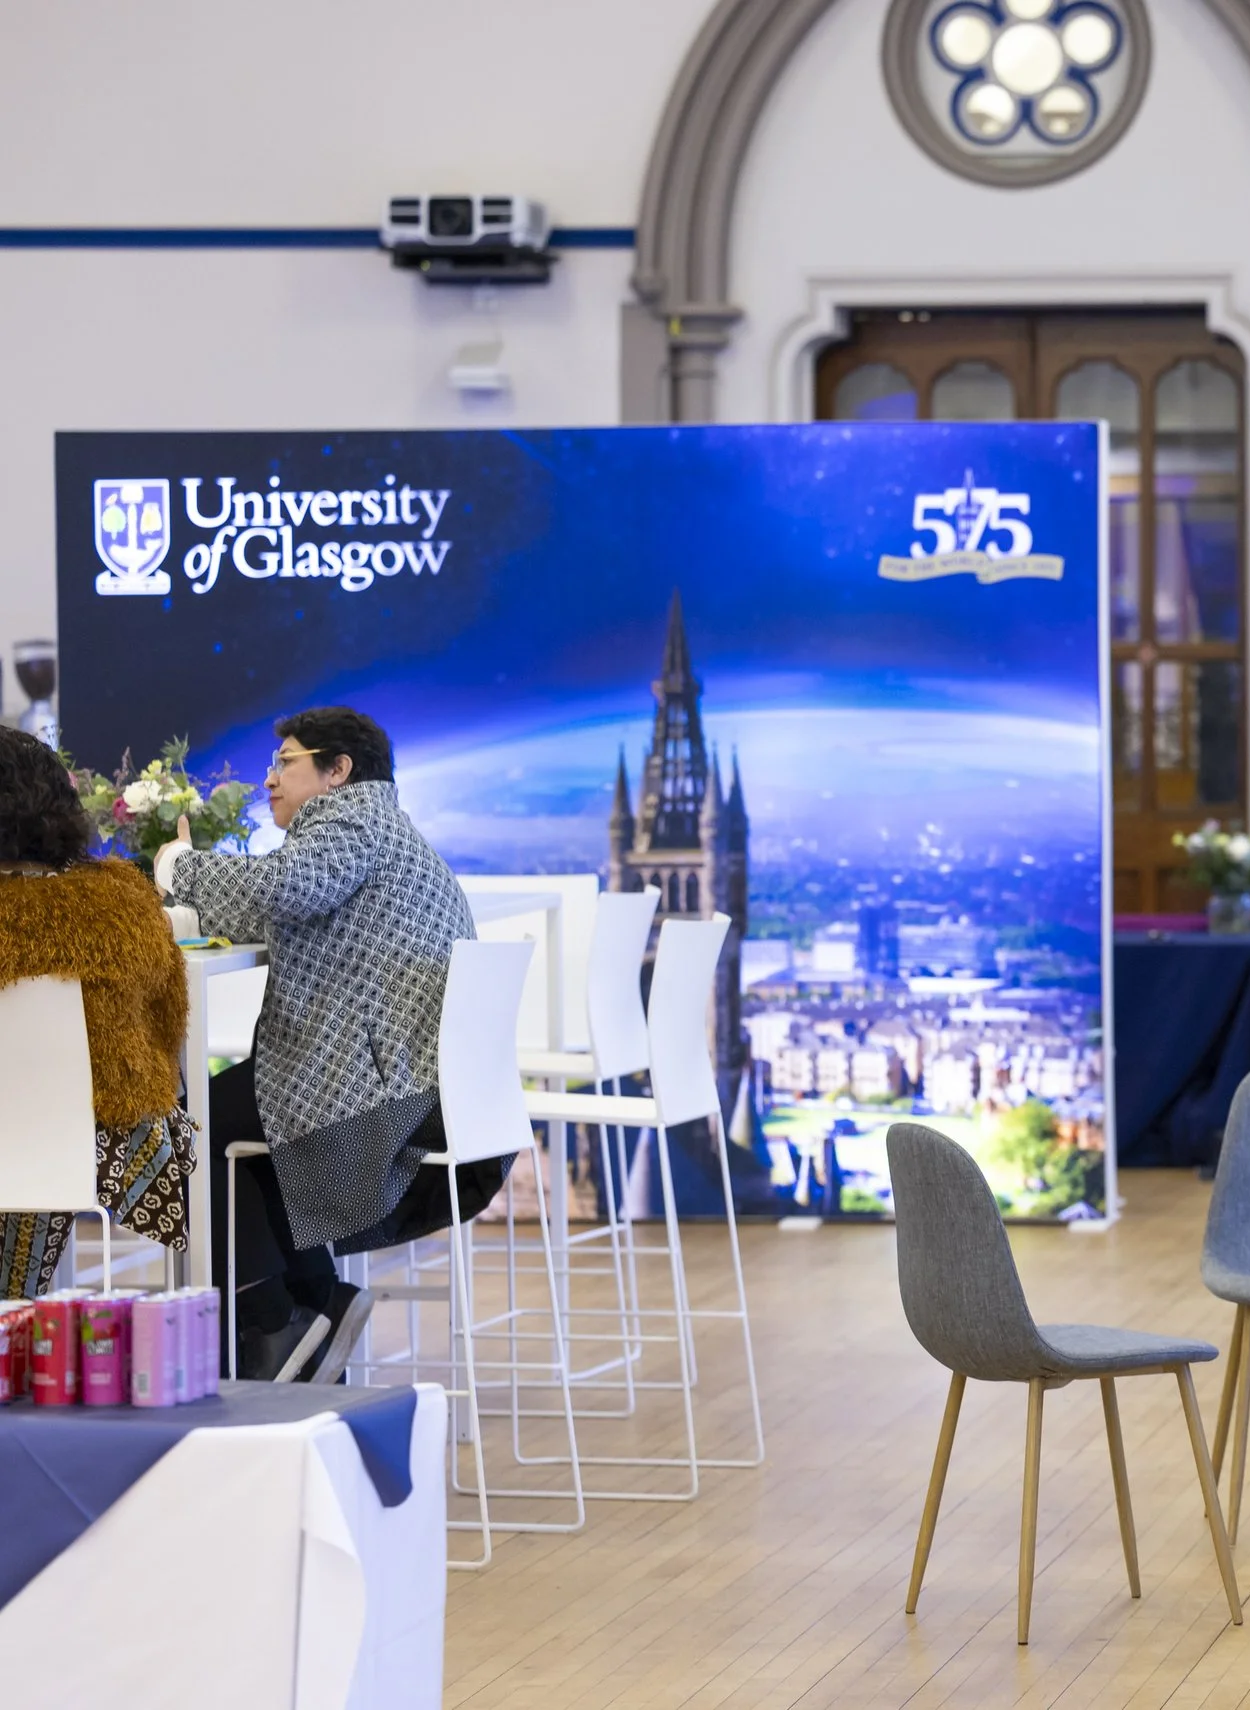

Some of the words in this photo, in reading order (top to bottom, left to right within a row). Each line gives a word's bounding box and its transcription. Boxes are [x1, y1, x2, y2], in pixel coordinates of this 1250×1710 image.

[180, 475, 452, 539] University
[910, 487, 1034, 560] 575
[183, 525, 238, 594] of
[232, 524, 452, 592] Glasgow
